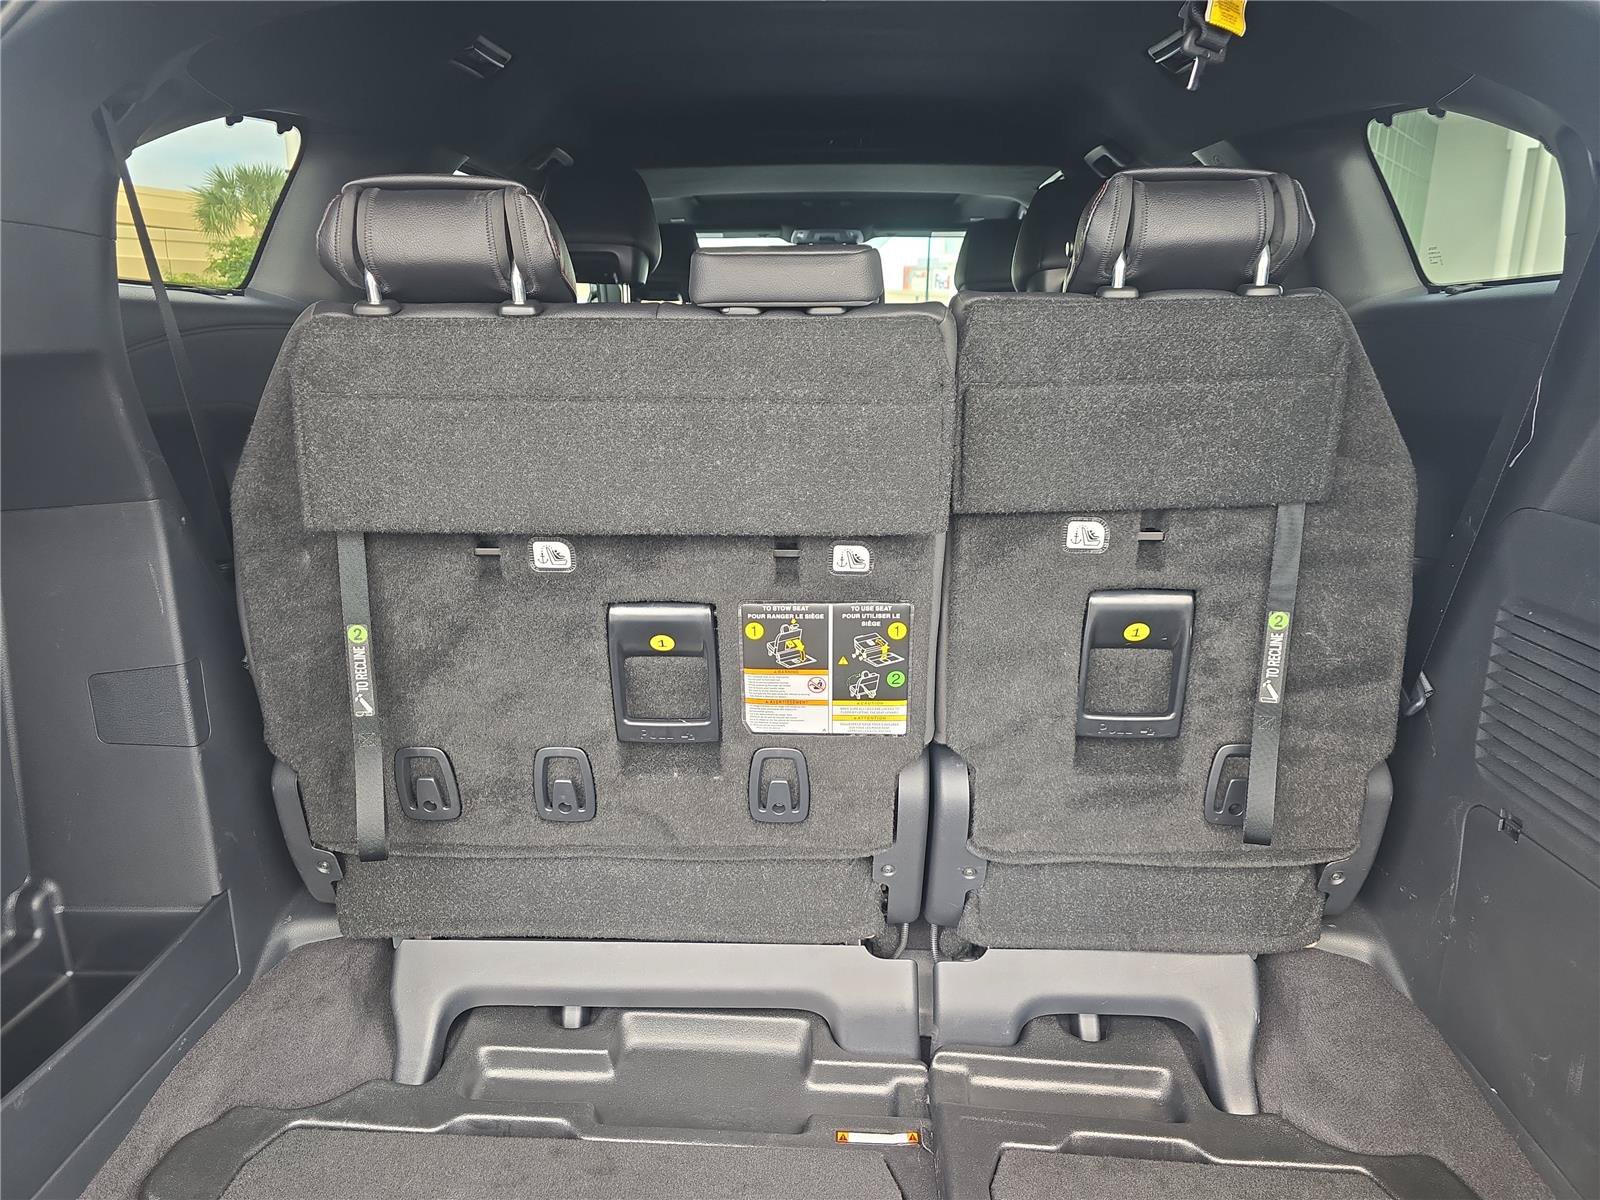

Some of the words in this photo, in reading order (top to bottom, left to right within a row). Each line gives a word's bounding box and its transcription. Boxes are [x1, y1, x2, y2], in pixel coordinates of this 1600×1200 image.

[1274, 615, 1283, 627] 2
[353, 628, 362, 640] 2
[1131, 628, 1140, 637] 1
[1267, 632, 1284, 667] RECLINE
[352, 646, 368, 680] RECLINE
[891, 673, 901, 685] 2
[1265, 667, 1280, 679] TO
[355, 681, 369, 693] TO
